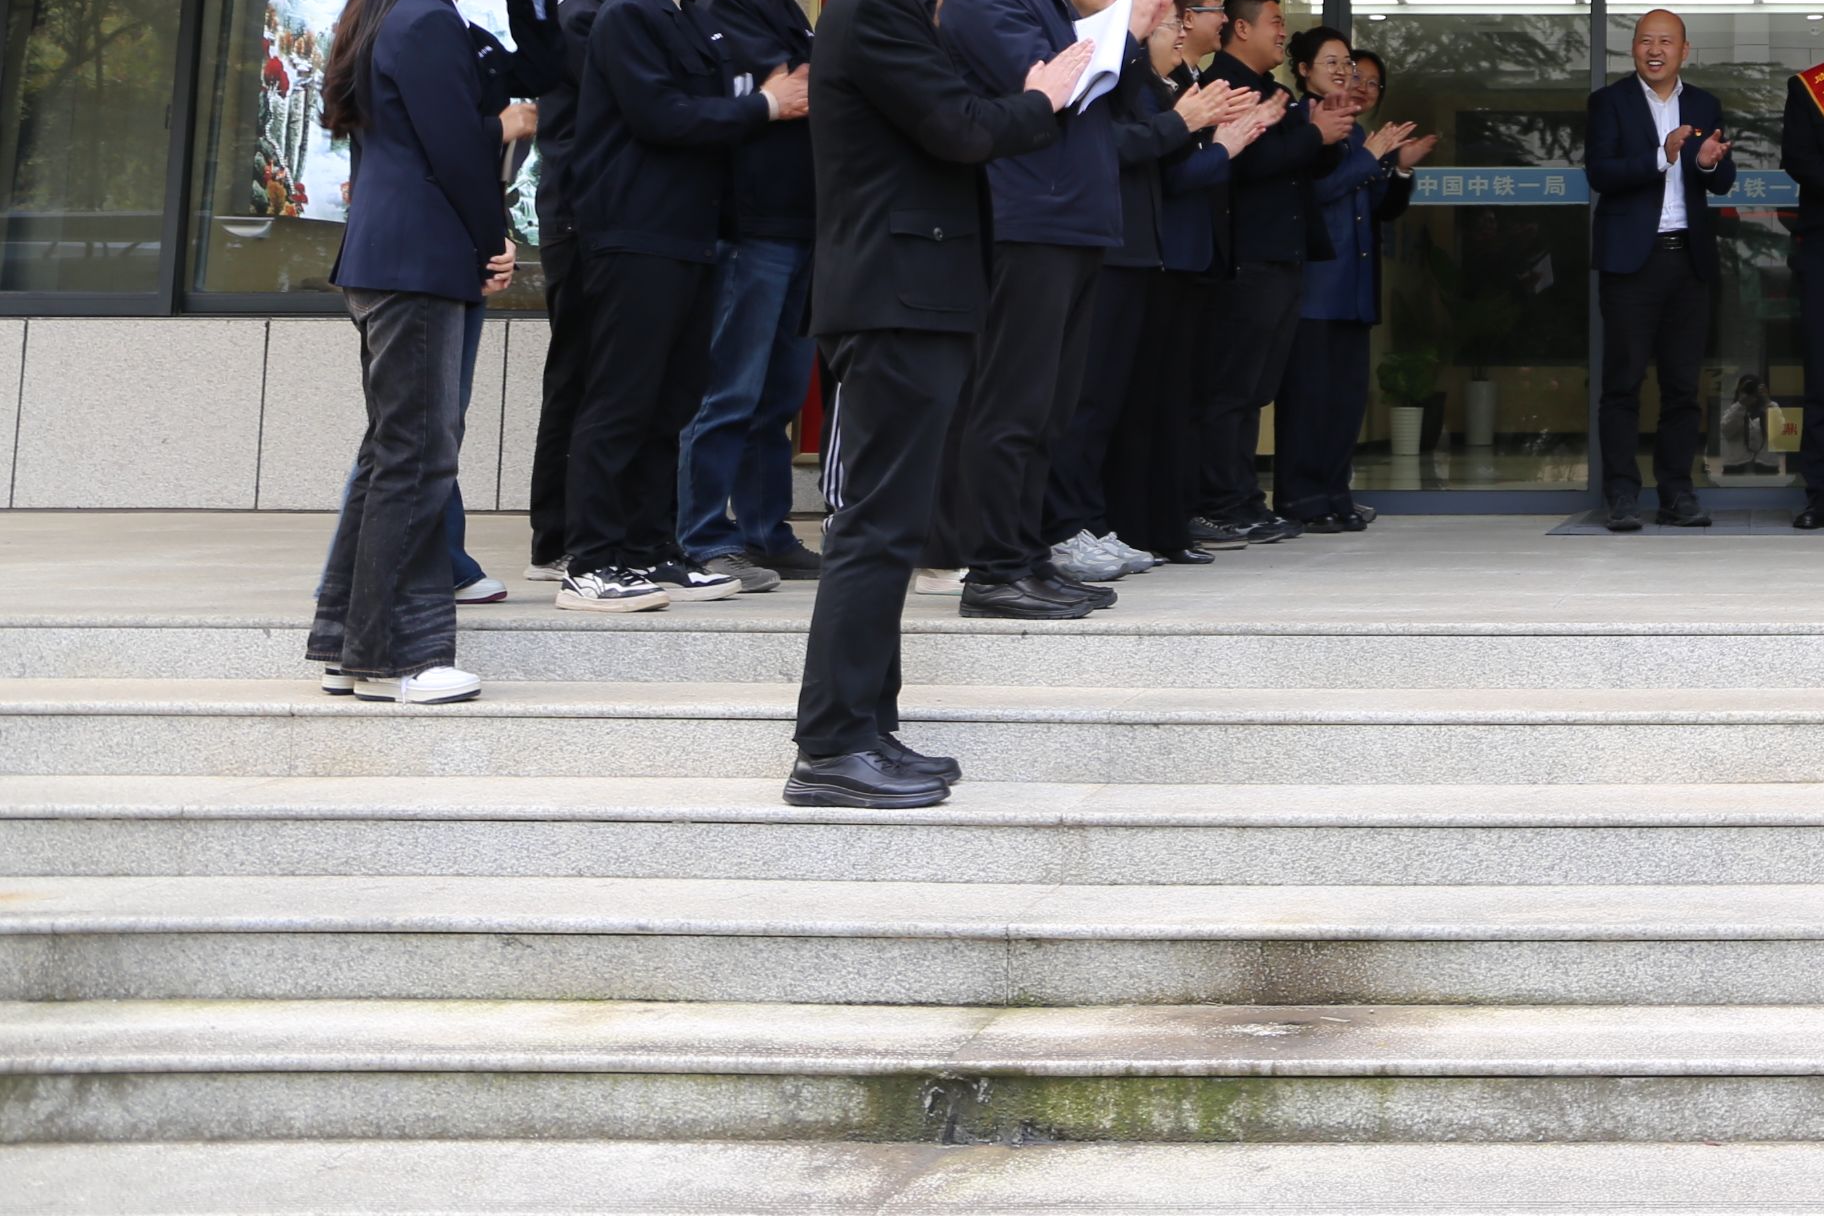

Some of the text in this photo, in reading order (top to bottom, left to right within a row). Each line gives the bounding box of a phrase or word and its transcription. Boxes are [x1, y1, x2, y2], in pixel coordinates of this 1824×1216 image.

[1417, 176, 1566, 196] 中国中铁一局
